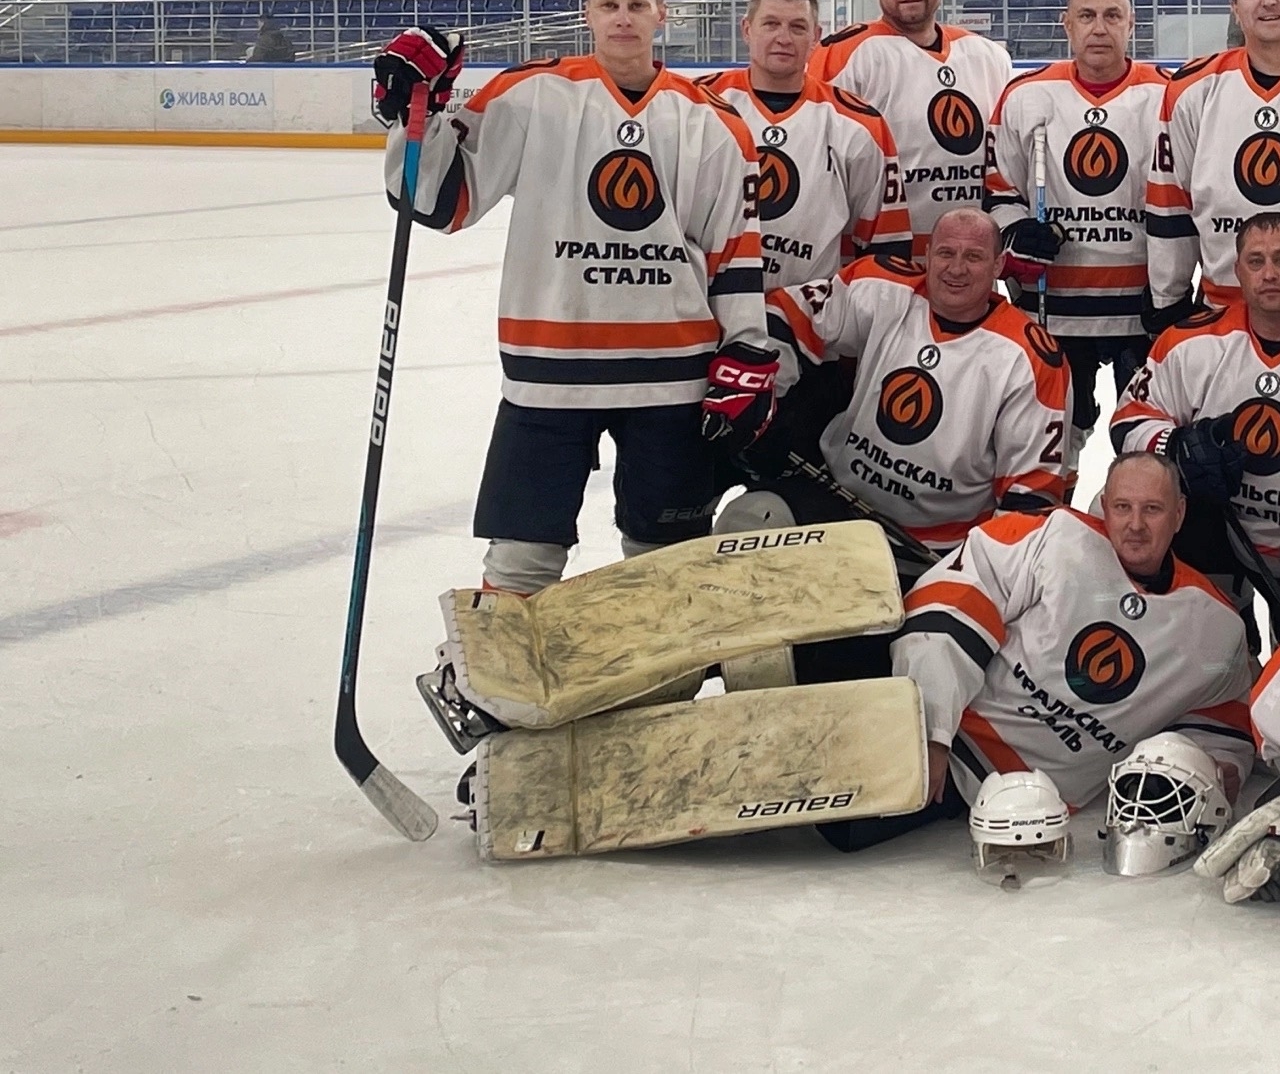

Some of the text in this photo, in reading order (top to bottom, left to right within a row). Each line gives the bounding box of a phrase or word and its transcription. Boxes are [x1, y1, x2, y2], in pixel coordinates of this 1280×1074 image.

[177, 90, 267, 108] ЖИВАЯ ВОДА
[905, 164, 985, 184] УРАЛЬС
[931, 186, 982, 202] СТАЛ
[1064, 227, 1133, 243] СТАЛЬ
[555, 240, 690, 264] УРАЛЬСКА
[582, 266, 673, 286] СТАЛЬ
[370, 299, 399, 447] BAUER
[845, 432, 953, 493] РАЛЬСКАЯ
[850, 458, 916, 502] СТАЛЬ
[657, 505, 715, 523] BAU
[717, 529, 825, 555] BAUER
[1012, 662, 1128, 755] УРАЛЬСКАЯ
[736, 792, 854, 820] BAUER
[1011, 818, 1046, 827] BAUER
